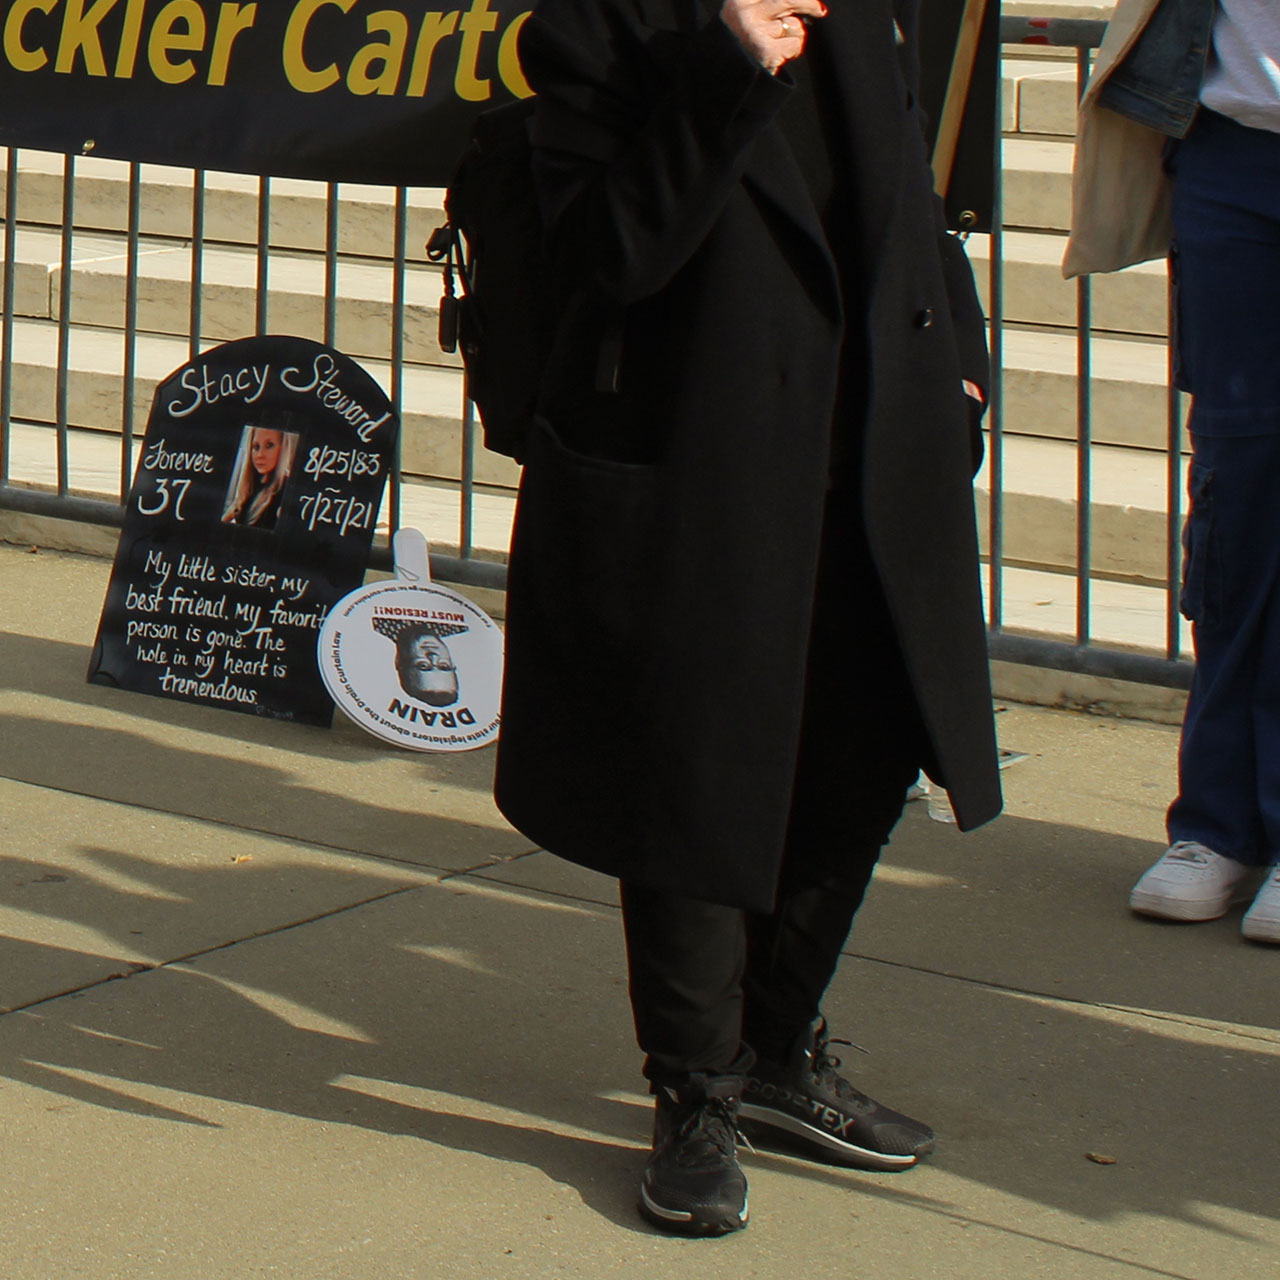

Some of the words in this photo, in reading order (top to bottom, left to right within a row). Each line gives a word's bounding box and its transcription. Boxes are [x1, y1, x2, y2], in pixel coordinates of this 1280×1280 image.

[168, 364, 270, 417] Stacy
[280, 354, 392, 443] Steward
[144, 438, 214, 474] Forever
[304, 445, 380, 482] 8/25/83
[137, 478, 192, 520] 37
[299, 492, 372, 536] 7/27/21
[144, 550, 171, 589] My
[177, 554, 216, 583] little
[222, 565, 276, 593] sister,
[125, 584, 163, 613] best
[269, 599, 328, 630] favorit
[373, 606, 428, 618] RESIGN!!
[431, 610, 465, 622] MUST
[126, 620, 178, 645] person
[185, 624, 202, 642] is
[201, 630, 246, 655] gone.
[255, 627, 287, 651] The
[332, 631, 342, 648] Law
[136, 643, 168, 665] hole
[173, 648, 188, 666] in
[194, 654, 215, 678] my
[223, 650, 269, 677] heart
[272, 657, 287, 678] is
[331, 649, 348, 684] Curtain
[158, 666, 258, 704] tremendous.
[345, 684, 365, 708] Drain
[364, 707, 380, 721] the
[379, 718, 411, 735] about
[388, 698, 476, 728] DRAIN
[412, 732, 467, 745] legislators
[466, 728, 489, 741] state
